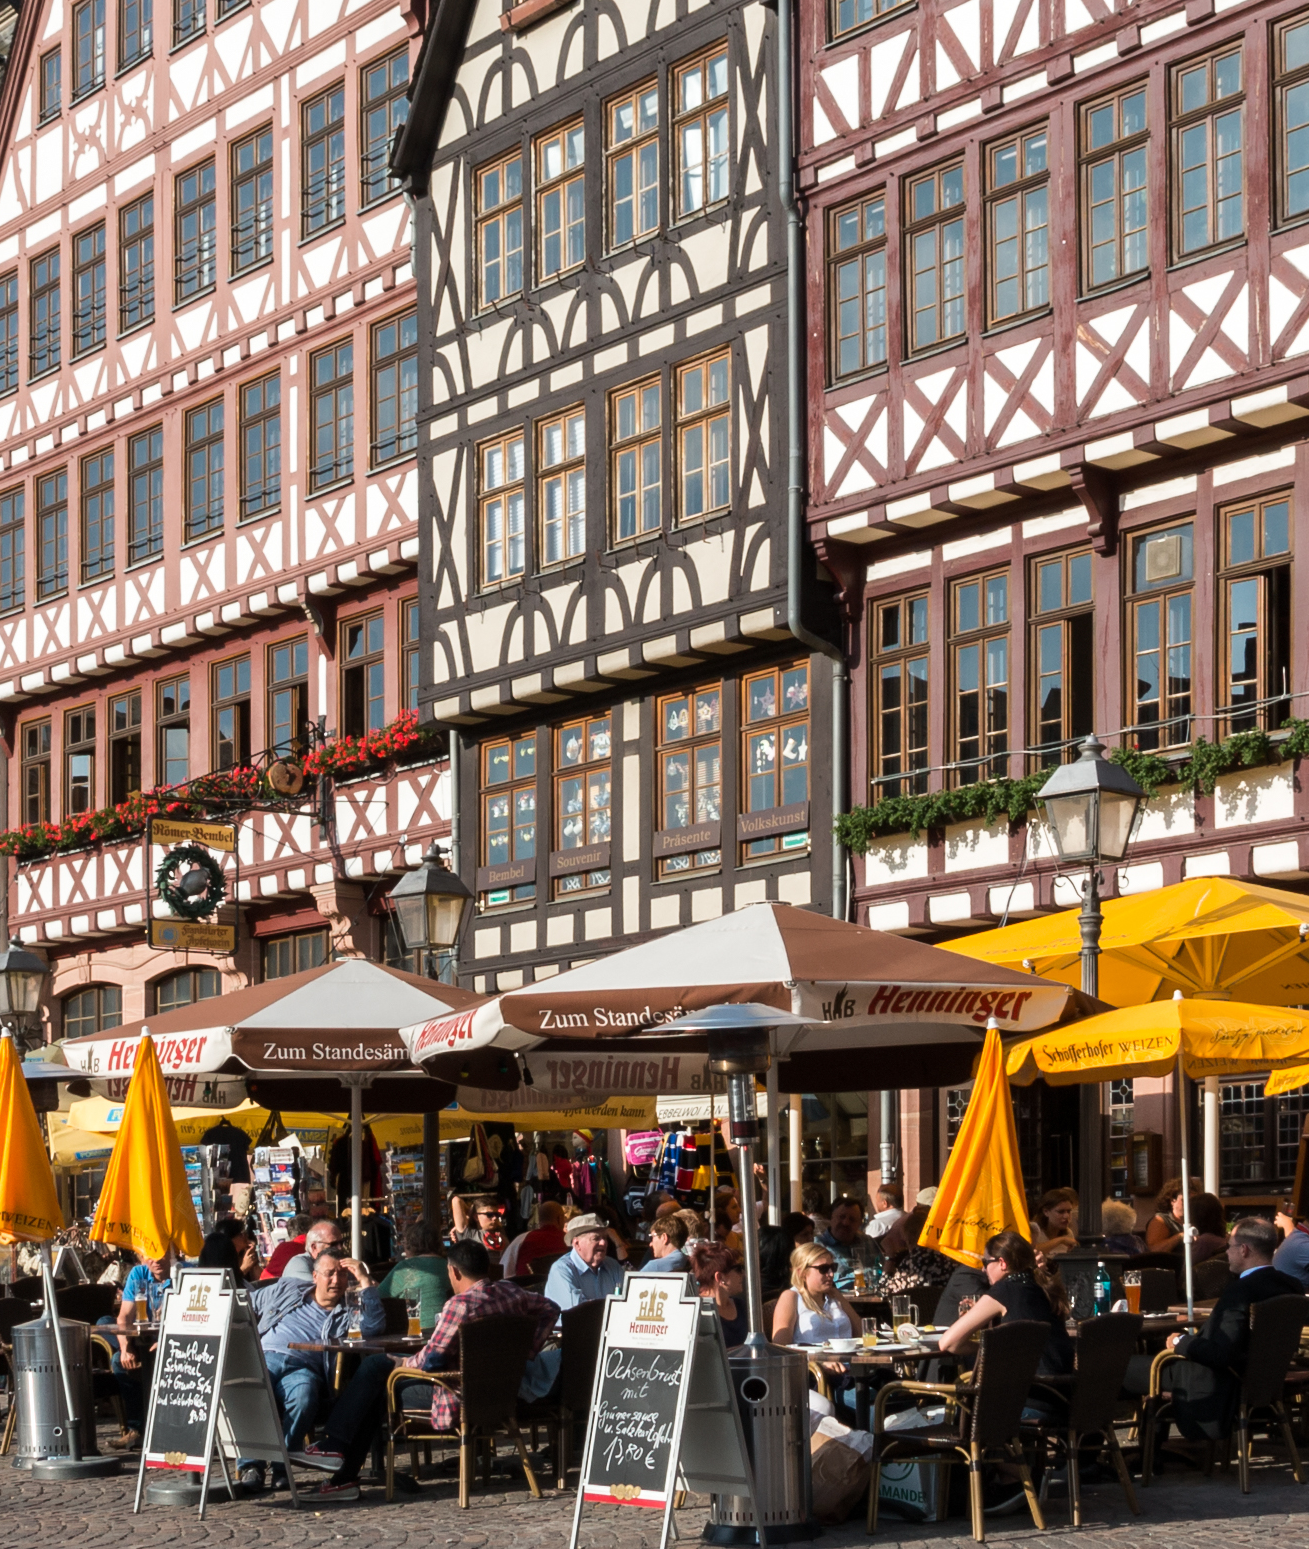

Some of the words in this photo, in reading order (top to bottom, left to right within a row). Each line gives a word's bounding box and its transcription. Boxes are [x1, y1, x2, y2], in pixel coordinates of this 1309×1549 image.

[741, 811, 806, 833] Volkskunst
[152, 823, 233, 843] Römer-Bembel
[663, 830, 711, 848] Präsente
[557, 850, 601, 869] Souvenir
[488, 865, 525, 883] Bembel
[867, 985, 1032, 1023] Henninger
[539, 1010, 589, 1029] Zum
[594, 1005, 695, 1027] Standesä
[107, 1035, 208, 1072] Heinger
[263, 1042, 307, 1060] Zum
[312, 1042, 410, 1061] Standesäm
[1042, 1039, 1114, 1067] Schöfferhofer
[1118, 1034, 1174, 1054] WEIZEN
[620, 1105, 647, 1118] kann.
[658, 1106, 701, 1120] EBBELWOI
[181, 1311, 211, 1323] Henninger
[629, 1321, 669, 1336] Henninger
[605, 1348, 683, 1386] Ochsenbrust
[620, 1381, 650, 1400] mit
[603, 1435, 643, 1472] 13,80
[644, 1450, 656, 1470] €
